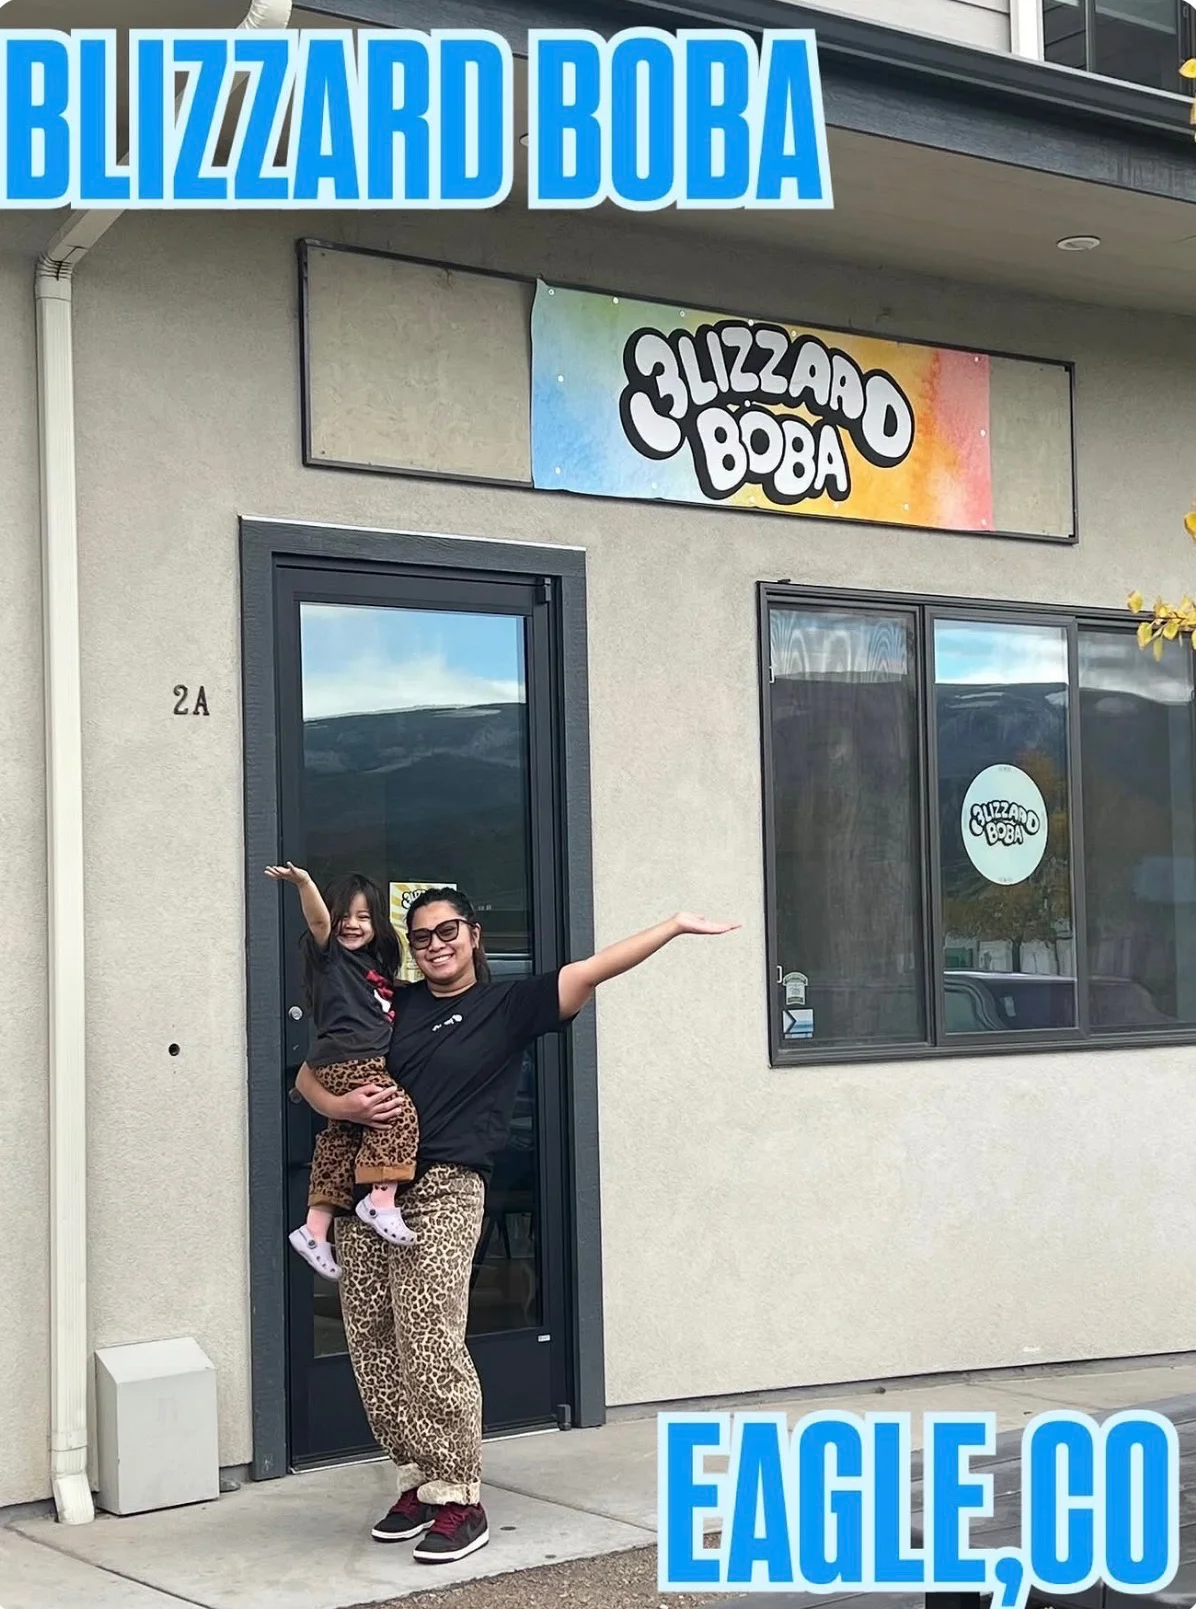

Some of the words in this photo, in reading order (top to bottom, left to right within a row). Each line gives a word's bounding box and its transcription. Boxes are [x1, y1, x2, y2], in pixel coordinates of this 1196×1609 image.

[622, 322, 913, 464] BLIZZARD
[695, 403, 850, 501] BOBA
[173, 684, 210, 716] 2A
[970, 801, 1040, 836] BLIZZARD
[985, 821, 1023, 846] BOBA
